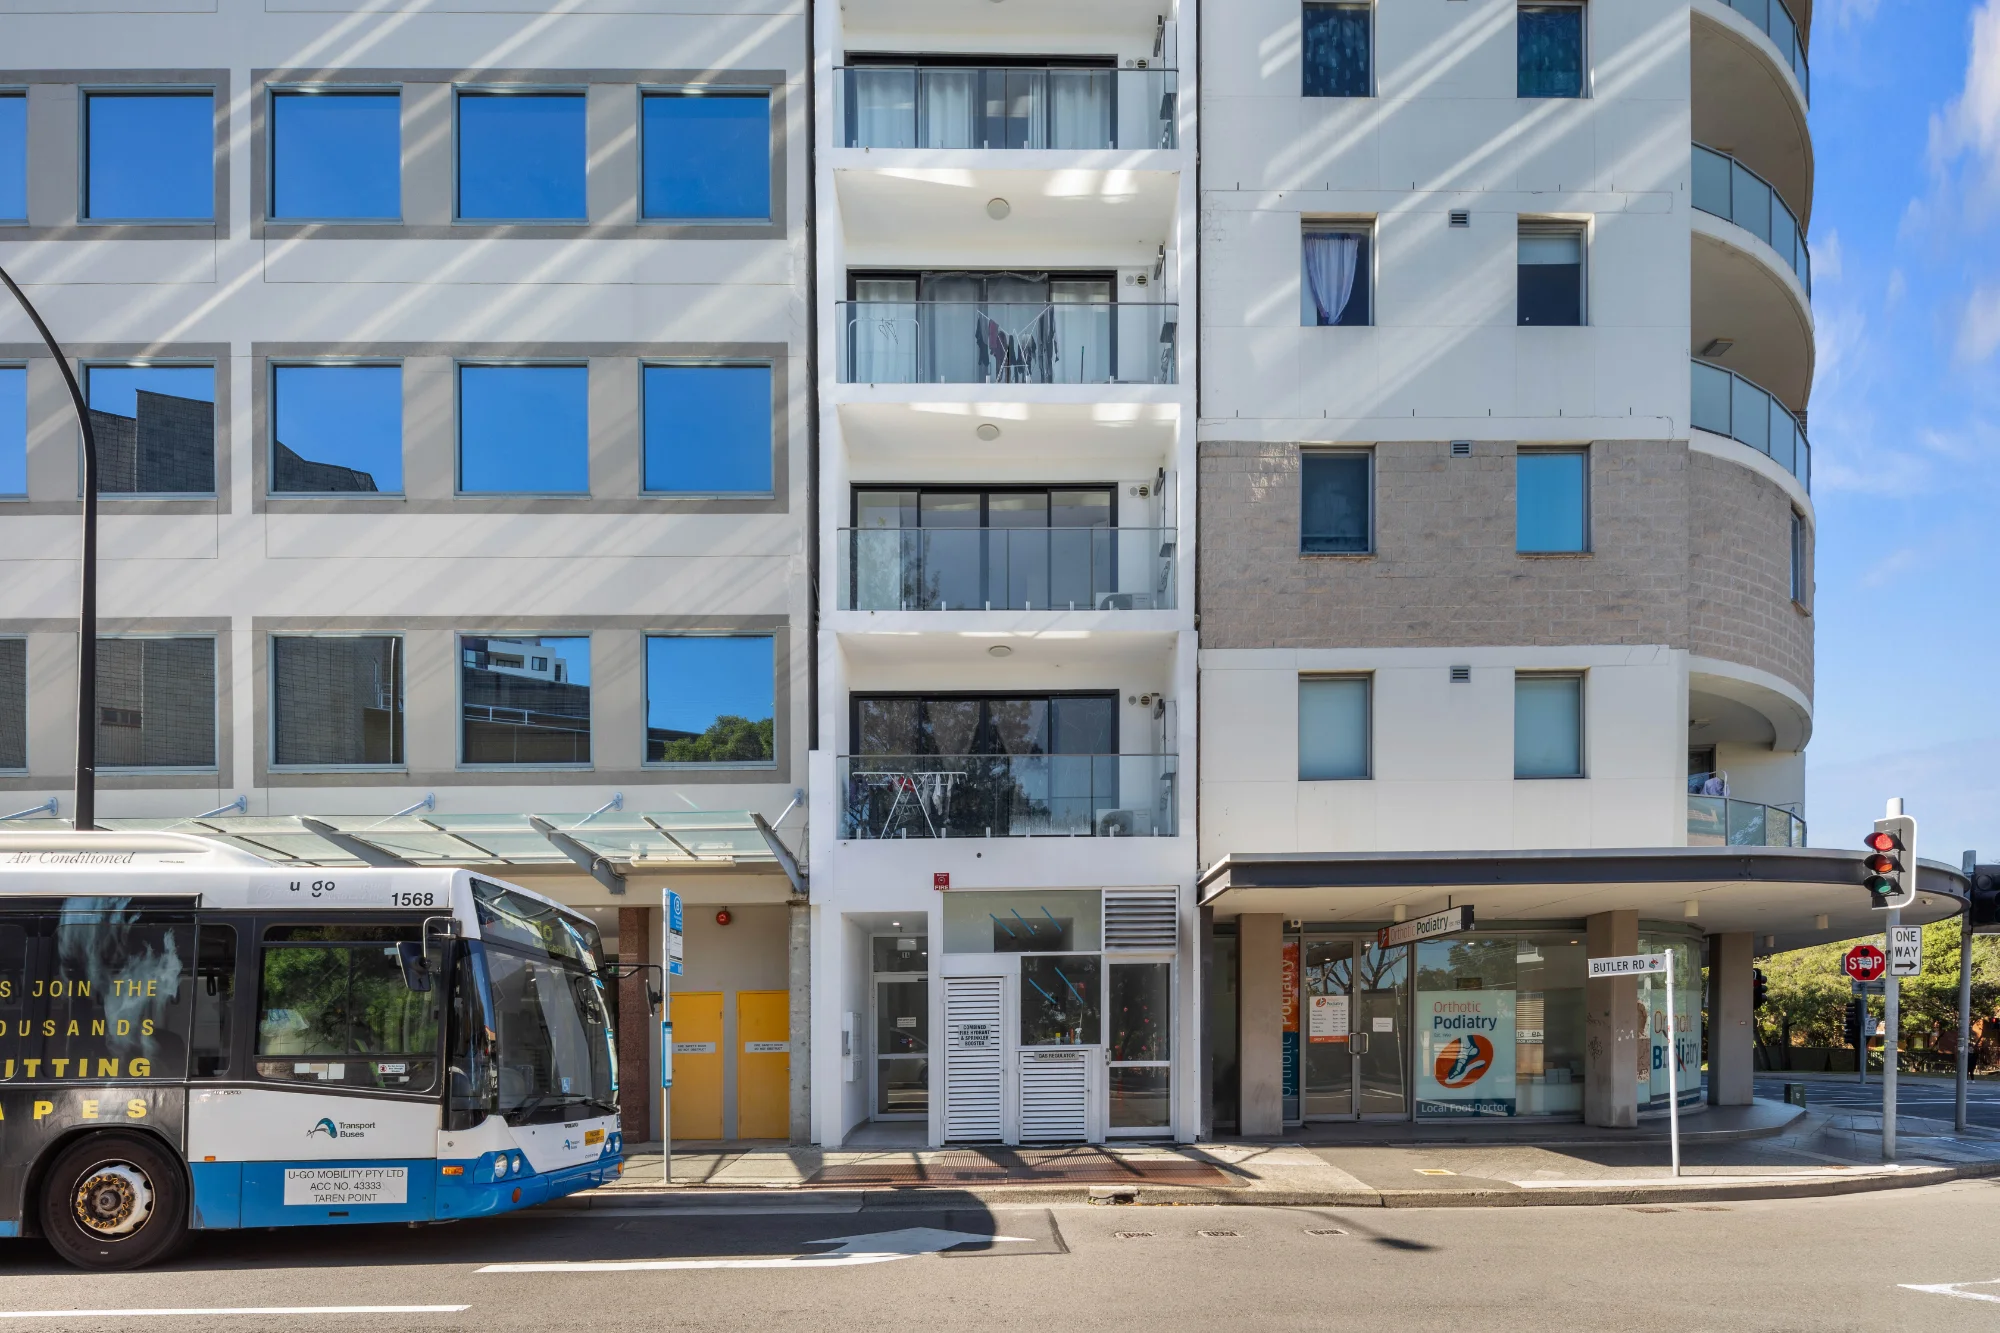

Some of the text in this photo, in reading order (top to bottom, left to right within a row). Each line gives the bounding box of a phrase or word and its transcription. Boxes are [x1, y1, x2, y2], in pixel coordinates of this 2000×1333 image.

[6, 852, 136, 864] Air Conditioned
[391, 892, 434, 907] 1568
[1390, 924, 1416, 942] Orthotic
[1416, 916, 1449, 935] Podiatry
[1895, 930, 1917, 942] ONE
[1894, 946, 1919, 958] WAY
[1593, 959, 1645, 973] BUTLER RD
[1848, 955, 1882, 970] STOP
[32, 980, 91, 998] JOIN
[113, 980, 158, 997] THE
[1433, 1001, 1481, 1013] Orthotic
[1433, 1014, 1498, 1031] Podiatry
[4, 1057, 151, 1078] ITTING
[1421, 1102, 1508, 1113] Local Foot Doctor
[339, 1121, 376, 1130] Transport
[340, 1130, 365, 1138] Buses
[288, 1169, 404, 1179] U-GO MOBILITY PTY LTD
[310, 1181, 382, 1191] ACC NO. 43333
[314, 1193, 378, 1203] TAREN POINT
